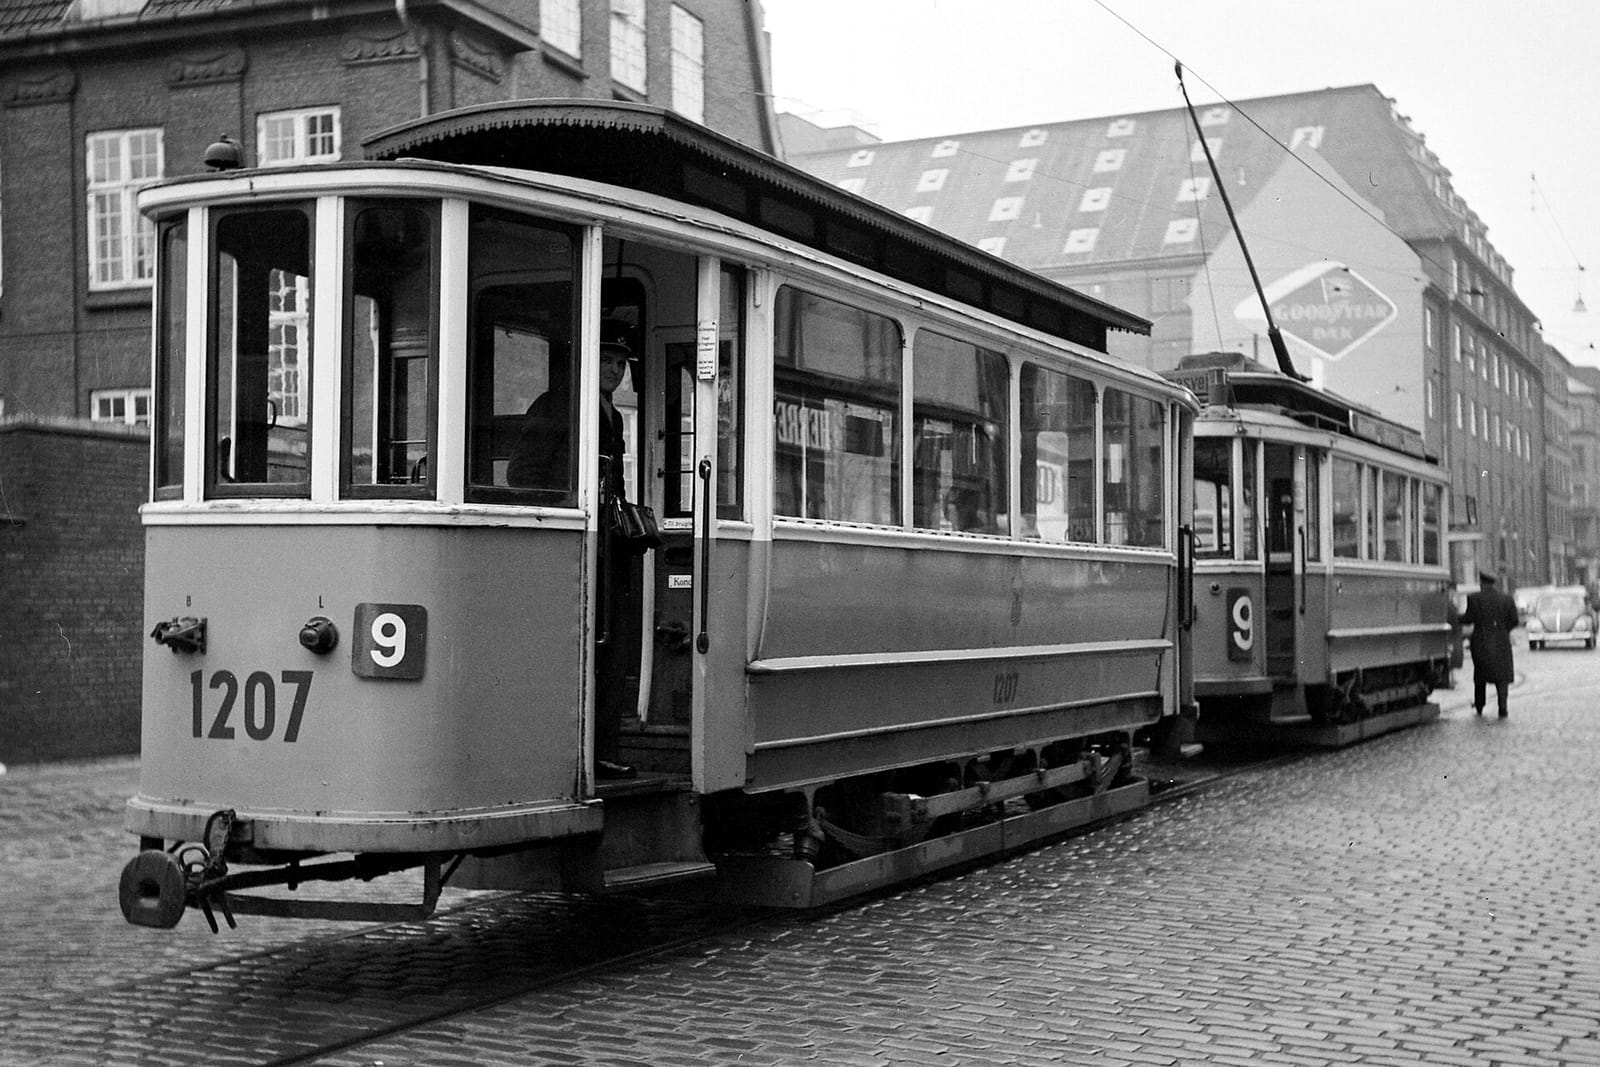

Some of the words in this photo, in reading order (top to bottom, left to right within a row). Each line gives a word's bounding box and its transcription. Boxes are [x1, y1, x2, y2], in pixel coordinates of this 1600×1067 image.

[370, 612, 407, 668] 9
[1233, 596, 1253, 650] 9
[190, 669, 314, 742] 1207
[993, 672, 1019, 703] 1207
